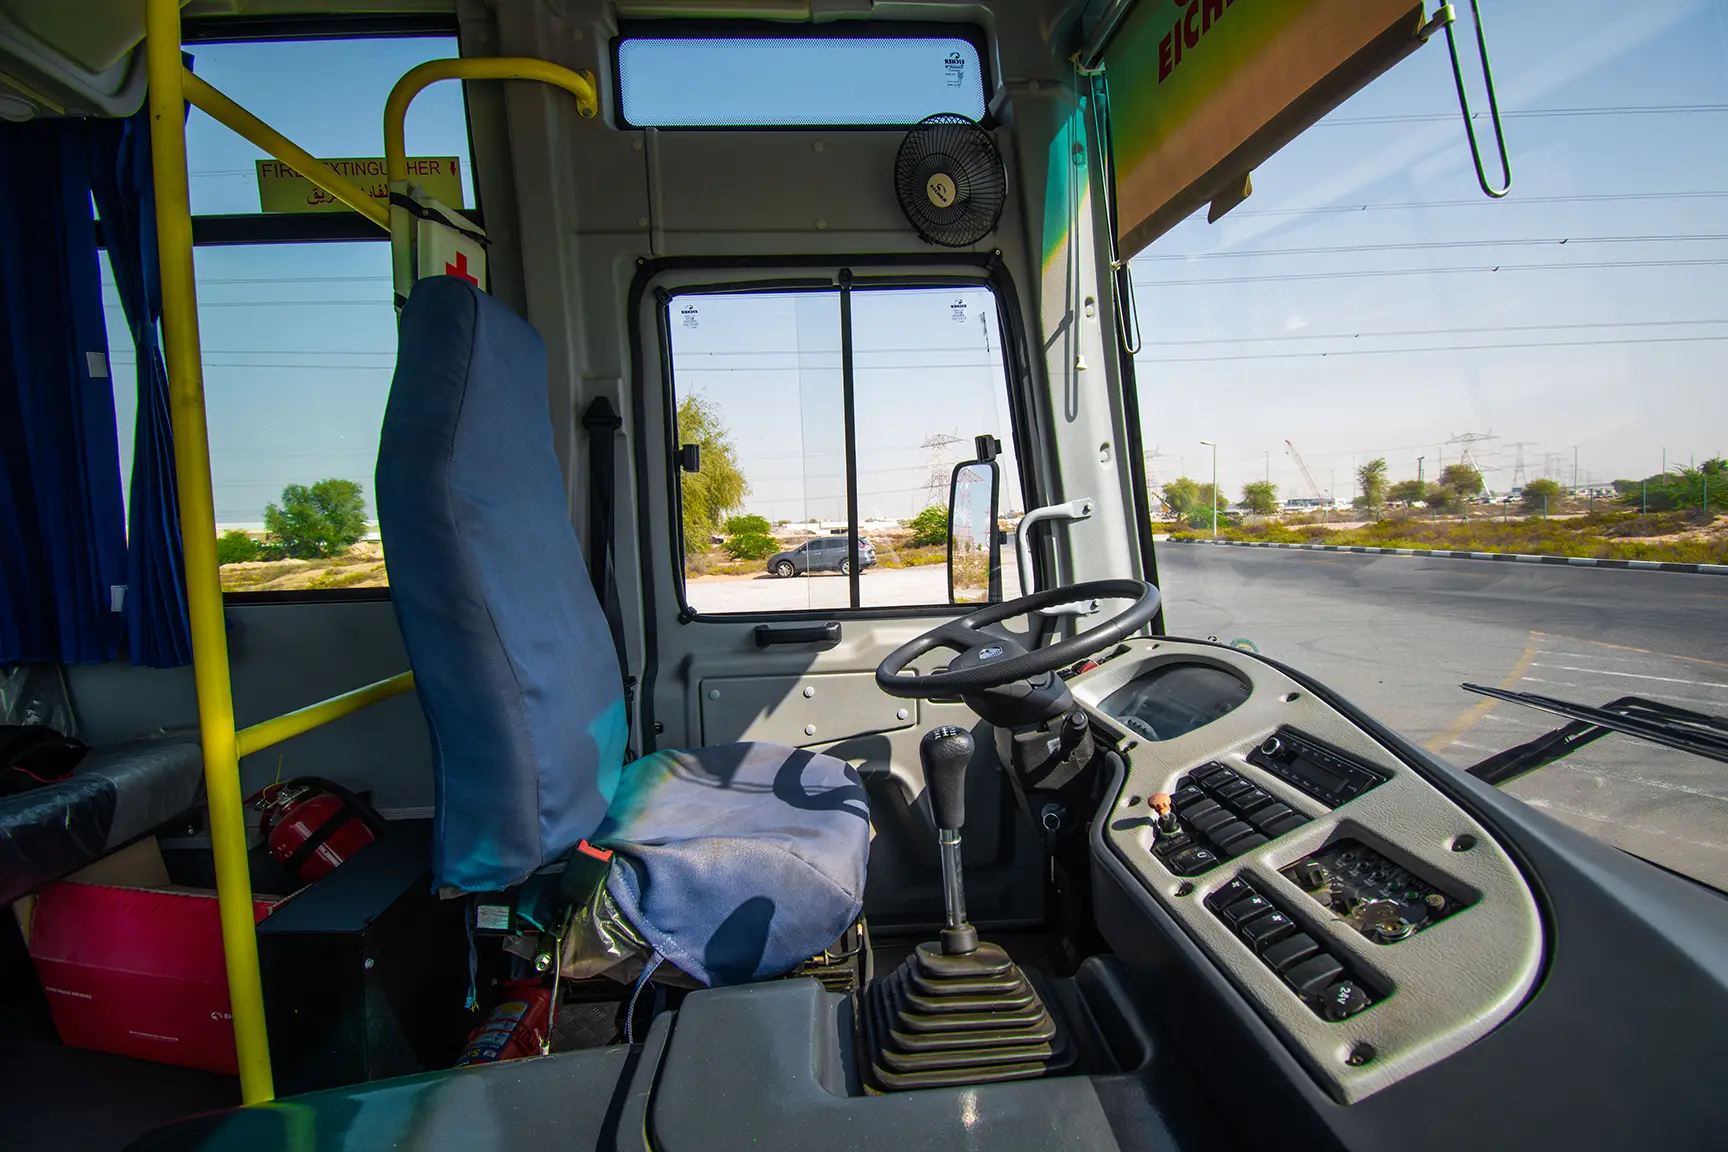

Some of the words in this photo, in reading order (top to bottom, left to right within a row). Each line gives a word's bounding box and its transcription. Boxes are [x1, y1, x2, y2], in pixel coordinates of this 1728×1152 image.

[1158, 0, 1236, 85] EICH
[322, 160, 441, 177] XTINGUHER
[1337, 986, 1352, 1005] 24V
